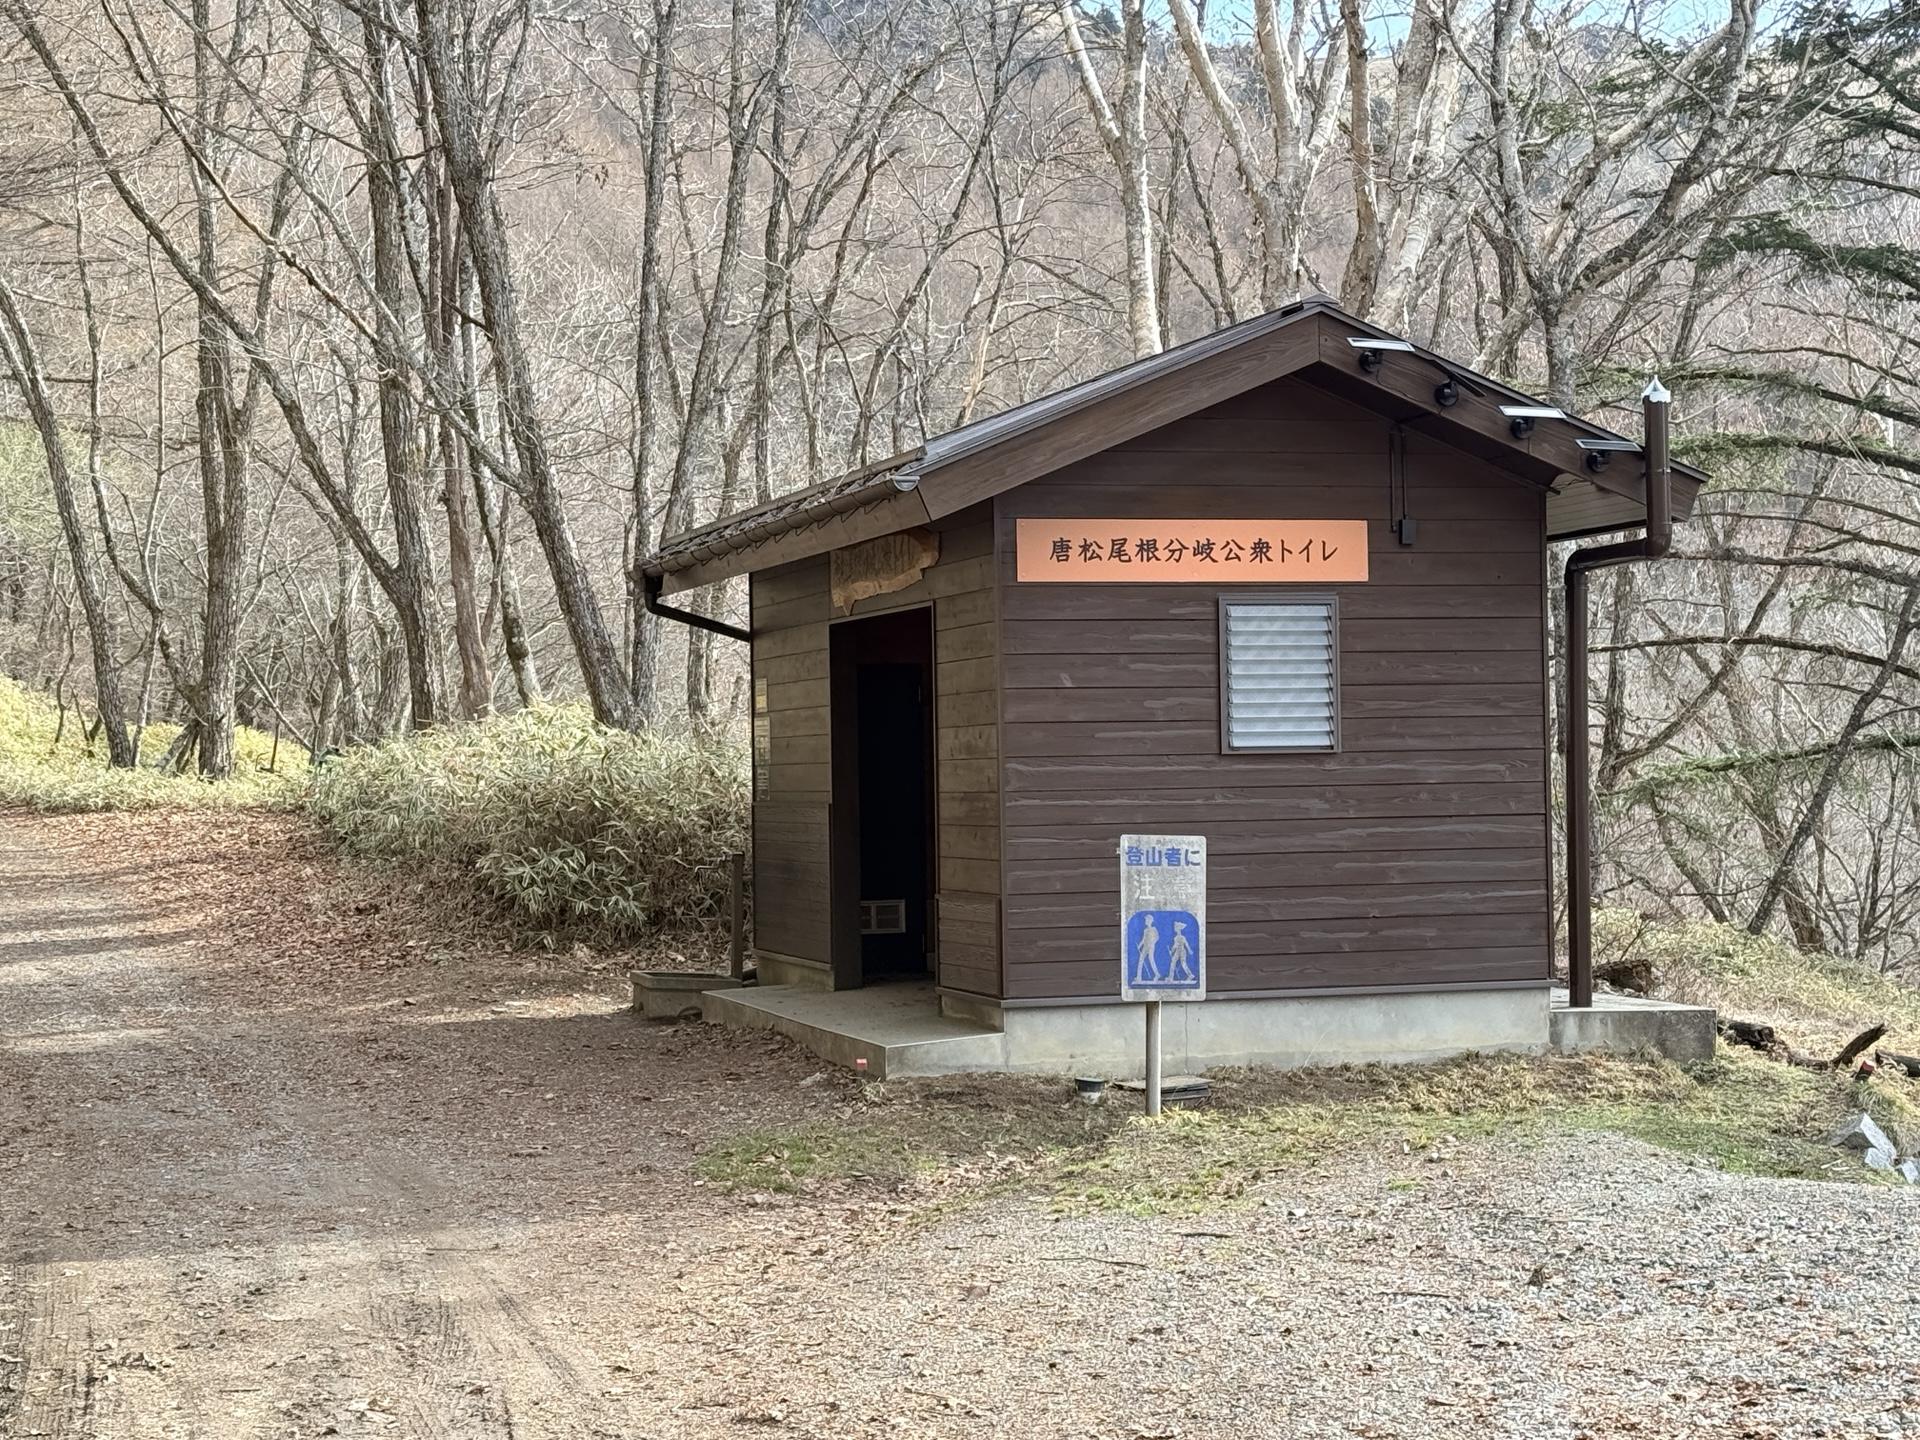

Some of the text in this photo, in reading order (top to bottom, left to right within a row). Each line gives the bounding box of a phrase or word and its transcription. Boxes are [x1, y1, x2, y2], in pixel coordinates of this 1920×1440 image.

[1049, 537, 1339, 564] 唐松尾根分岐公衆トイレ
[1125, 846, 1201, 867] 登山者に
